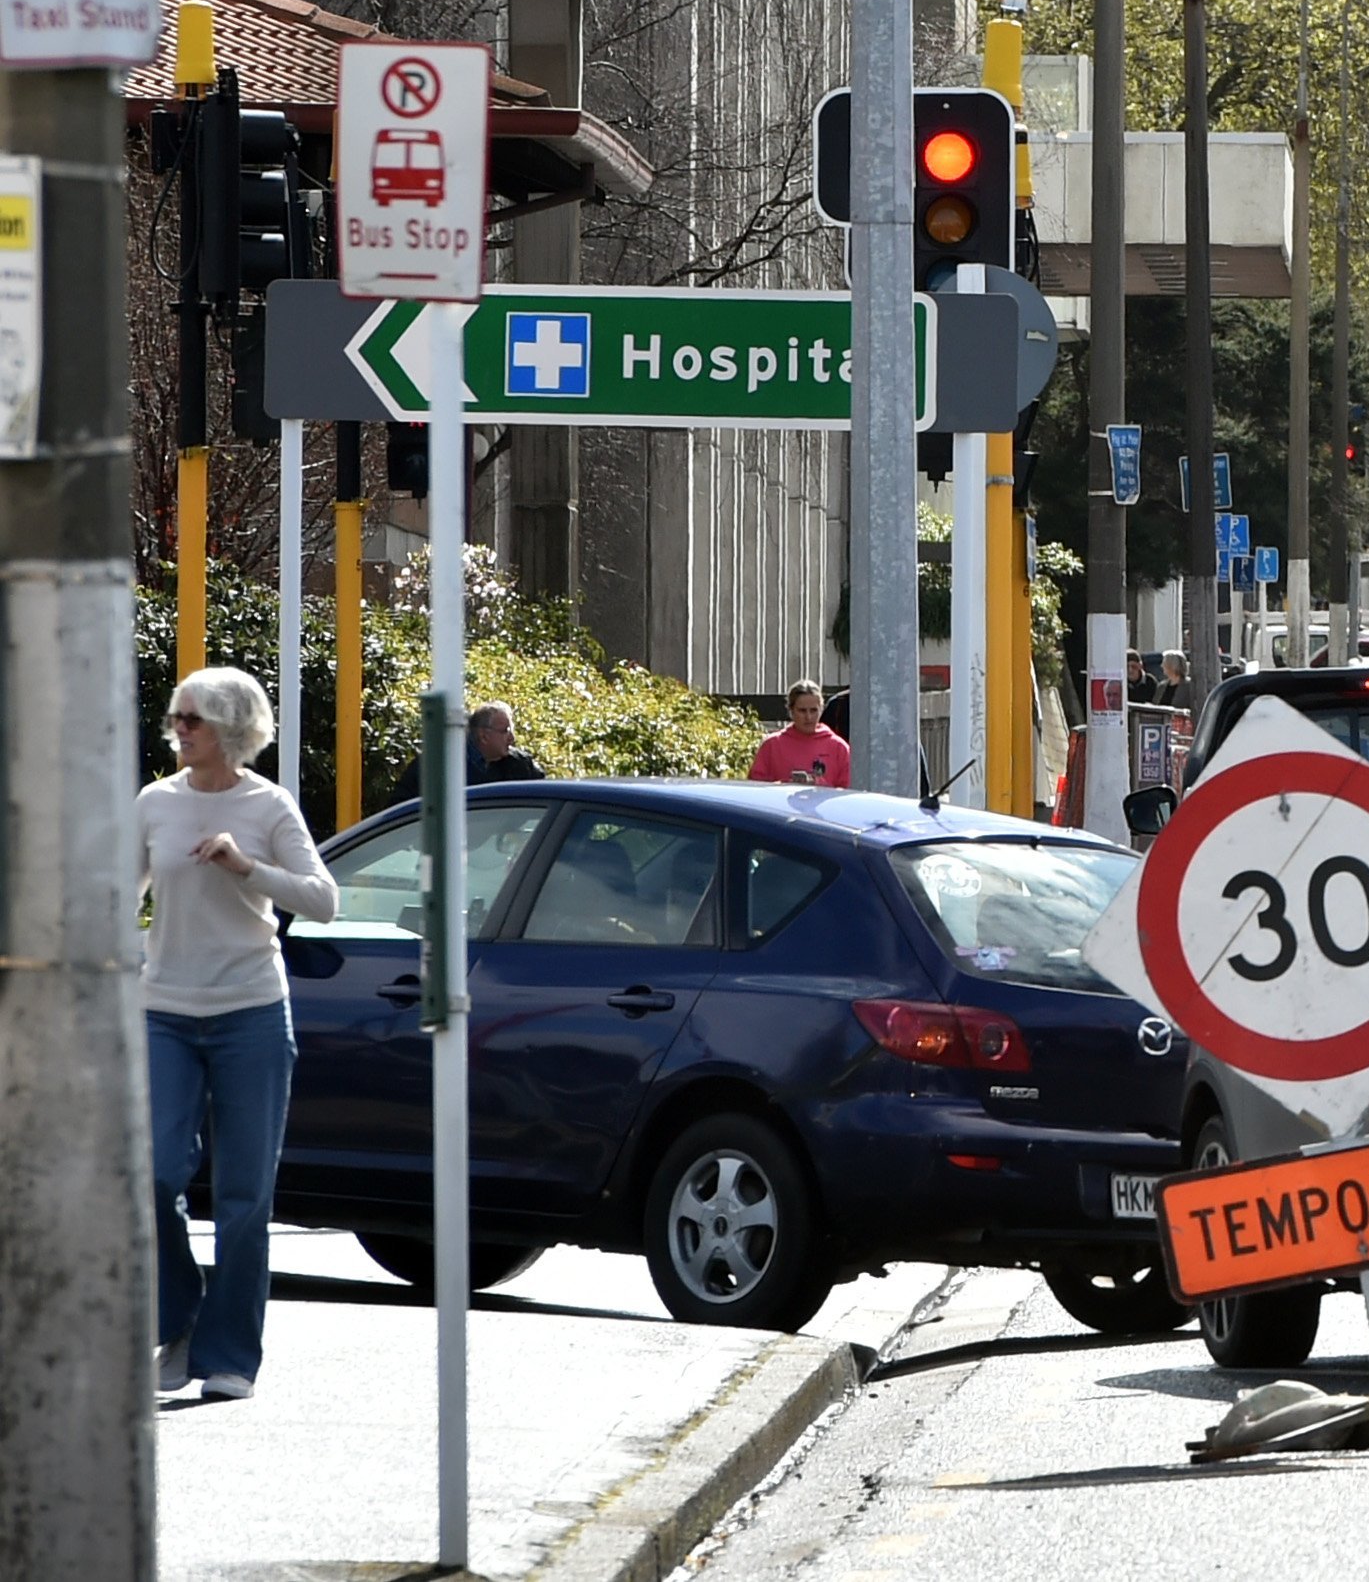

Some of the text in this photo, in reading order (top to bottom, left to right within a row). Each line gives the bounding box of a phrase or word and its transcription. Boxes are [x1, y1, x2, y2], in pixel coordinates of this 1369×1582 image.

[12, 0, 69, 31] Taxi
[347, 217, 470, 258] Bus Stop
[622, 333, 852, 394] Hospita
[1143, 728, 1160, 750] P
[1116, 1180, 1158, 1212] HKM
